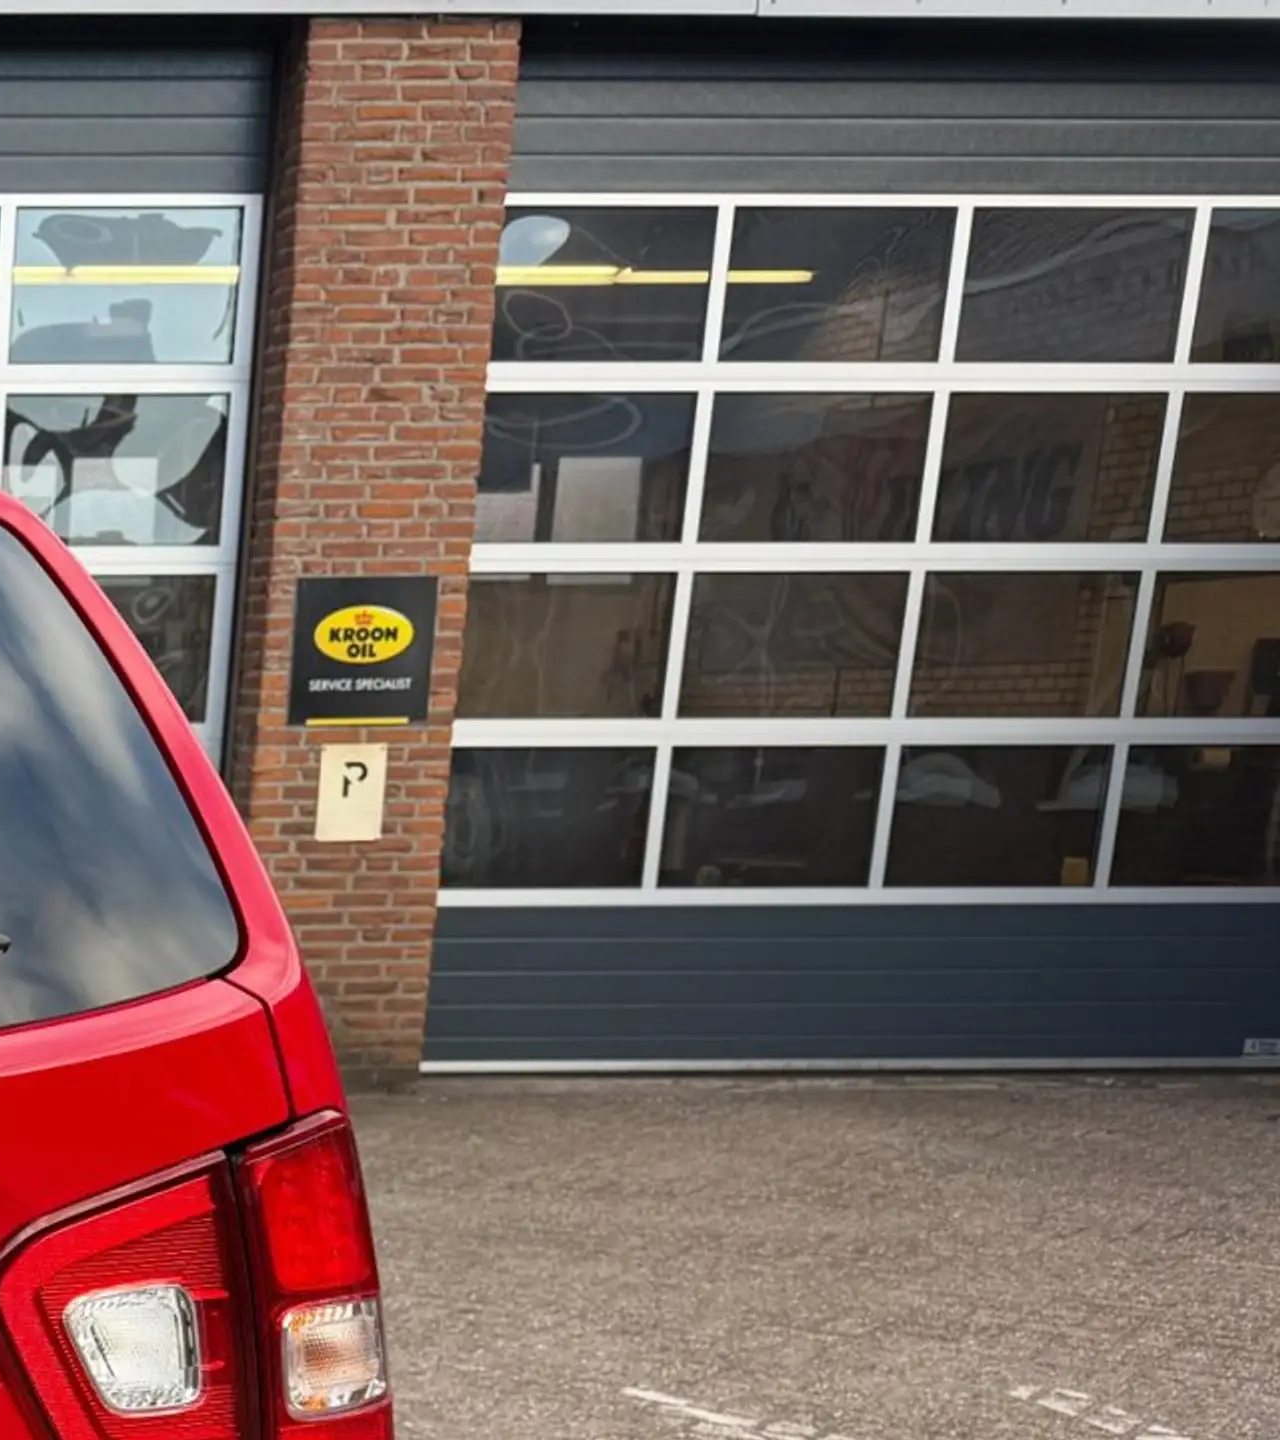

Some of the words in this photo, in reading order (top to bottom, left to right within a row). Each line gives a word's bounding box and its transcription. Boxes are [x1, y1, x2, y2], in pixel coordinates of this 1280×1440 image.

[329, 627, 398, 642] KROON
[346, 644, 377, 658] OIL
[308, 678, 352, 692] SERVICE
[355, 677, 413, 692] SPECIALIST
